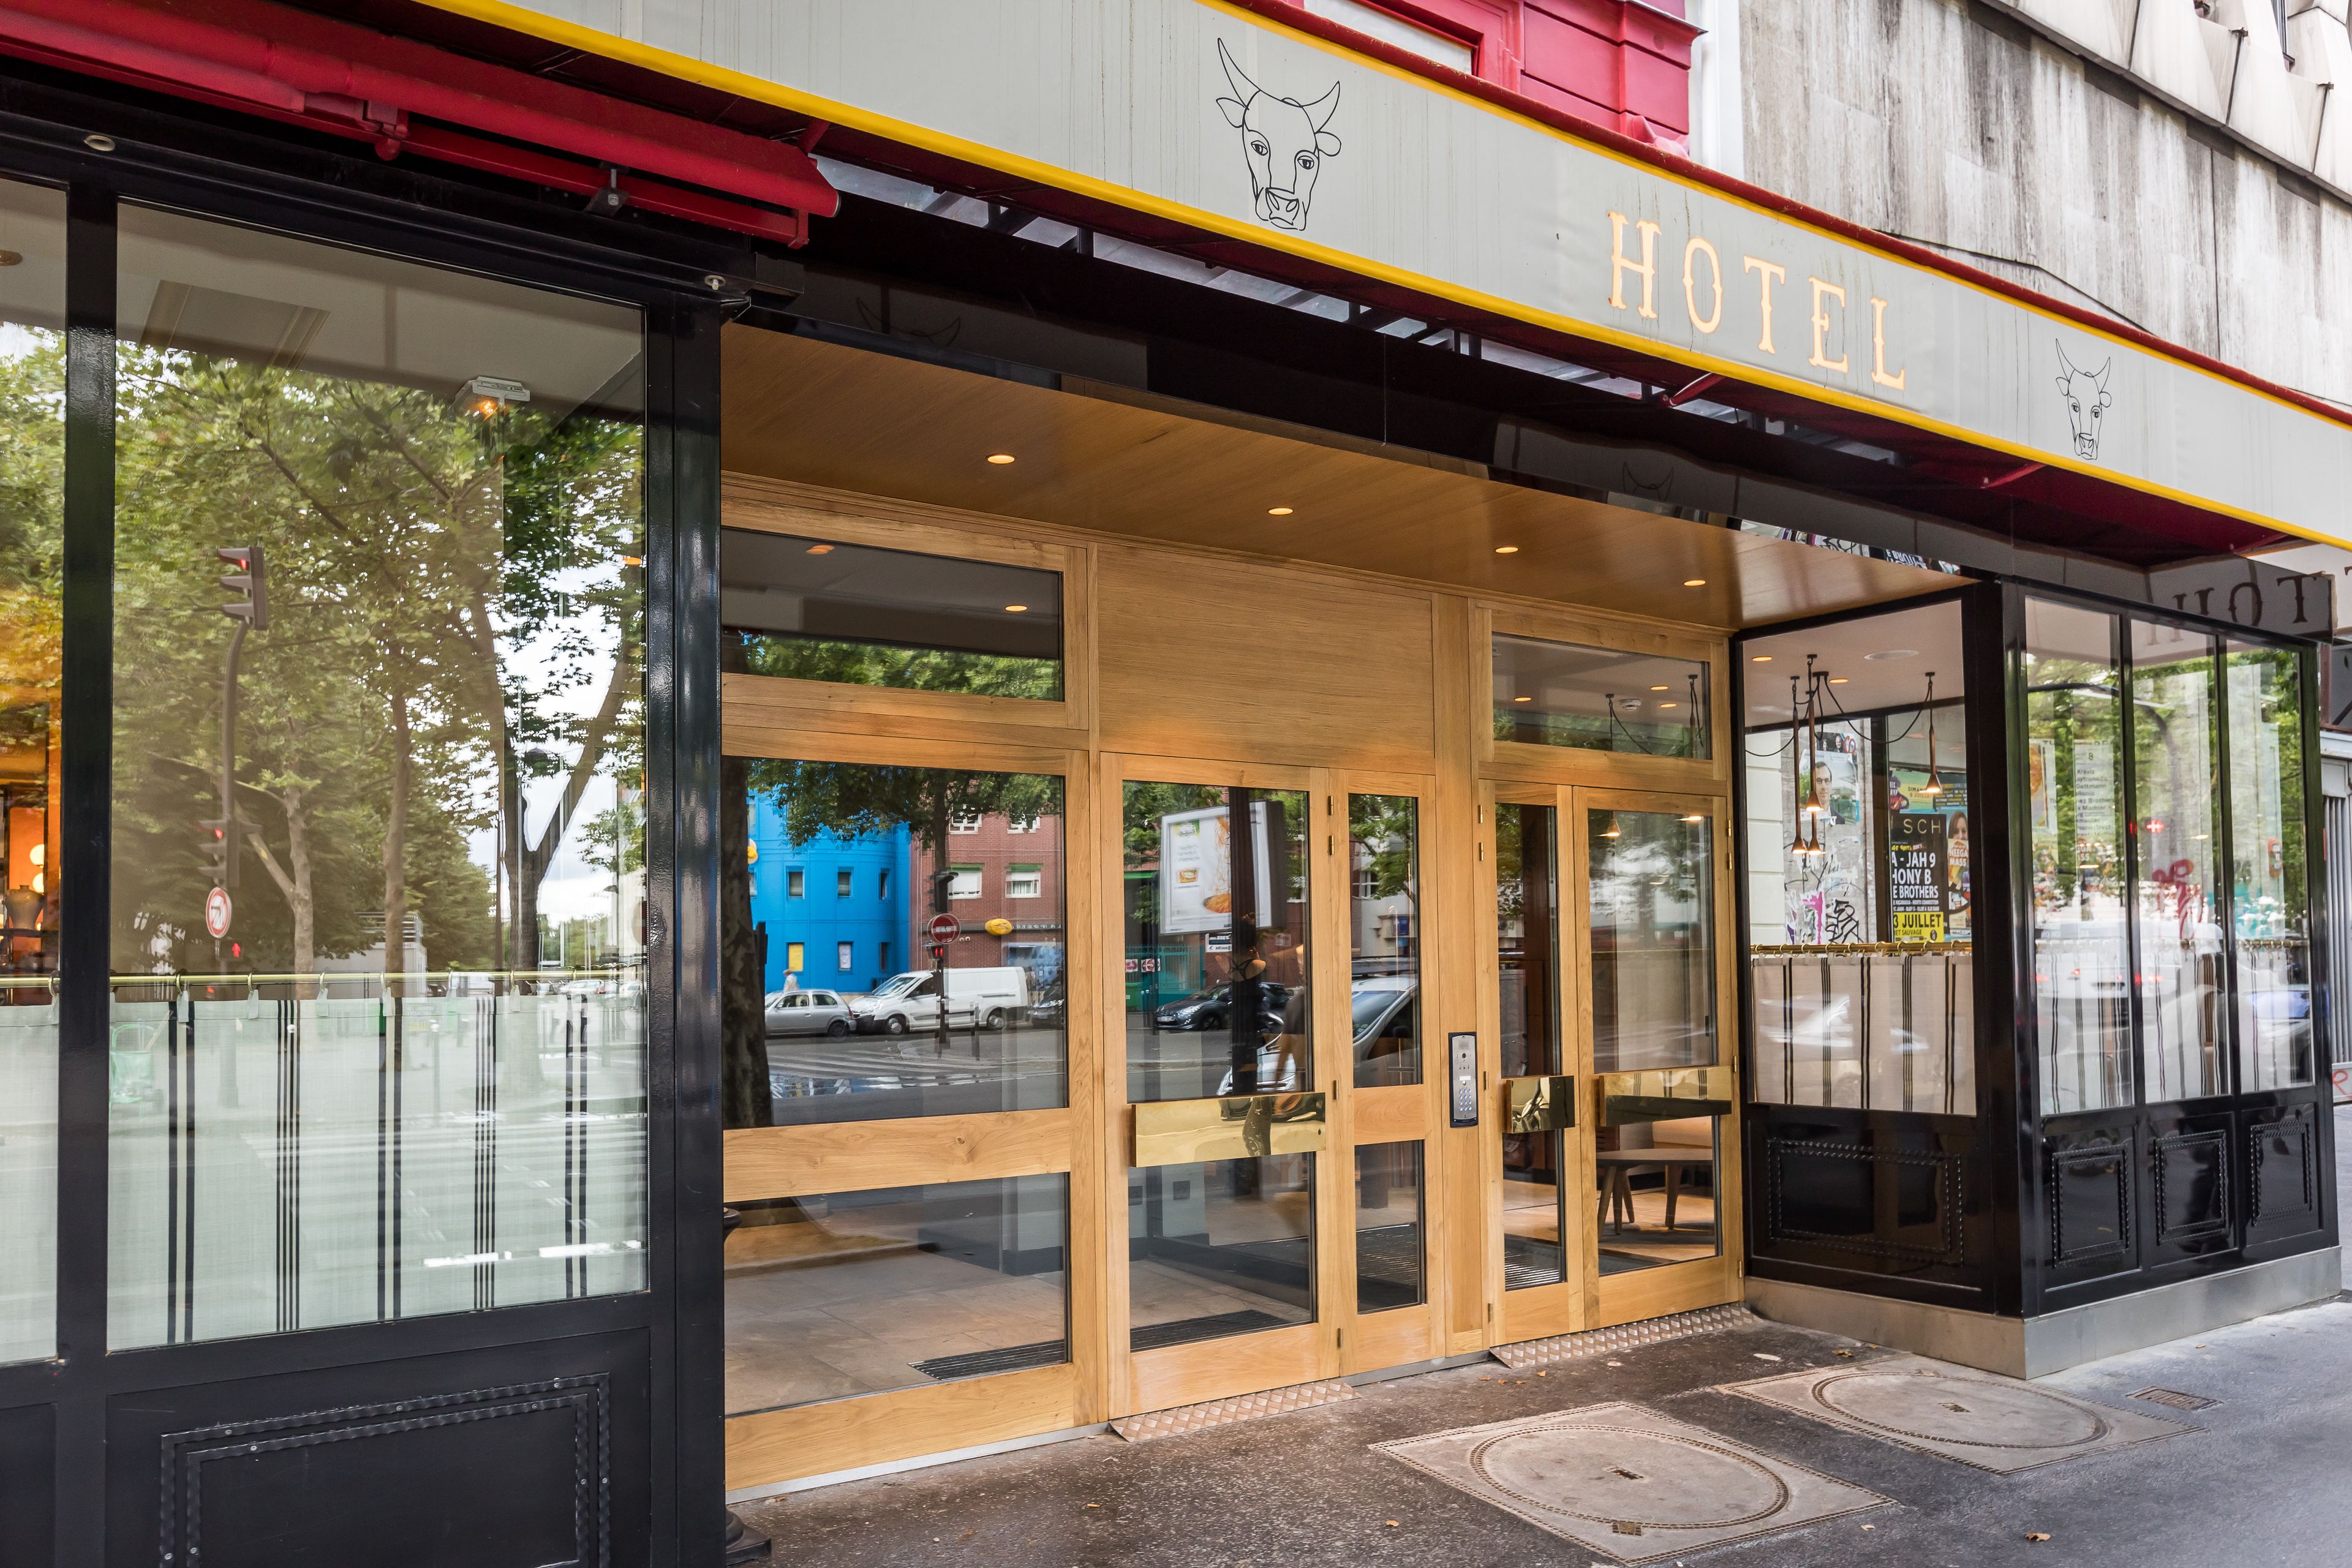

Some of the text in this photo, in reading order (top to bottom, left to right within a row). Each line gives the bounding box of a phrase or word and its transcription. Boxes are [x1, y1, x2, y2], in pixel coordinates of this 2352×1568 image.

[1608, 211, 1905, 390] HOTEL
[1906, 851, 1927, 867] JAH
[1929, 852, 1936, 868] 9
[1924, 869, 1932, 884] B
[1899, 885, 1939, 899] BROTHERS
[1902, 914, 1941, 928] JUILLET
